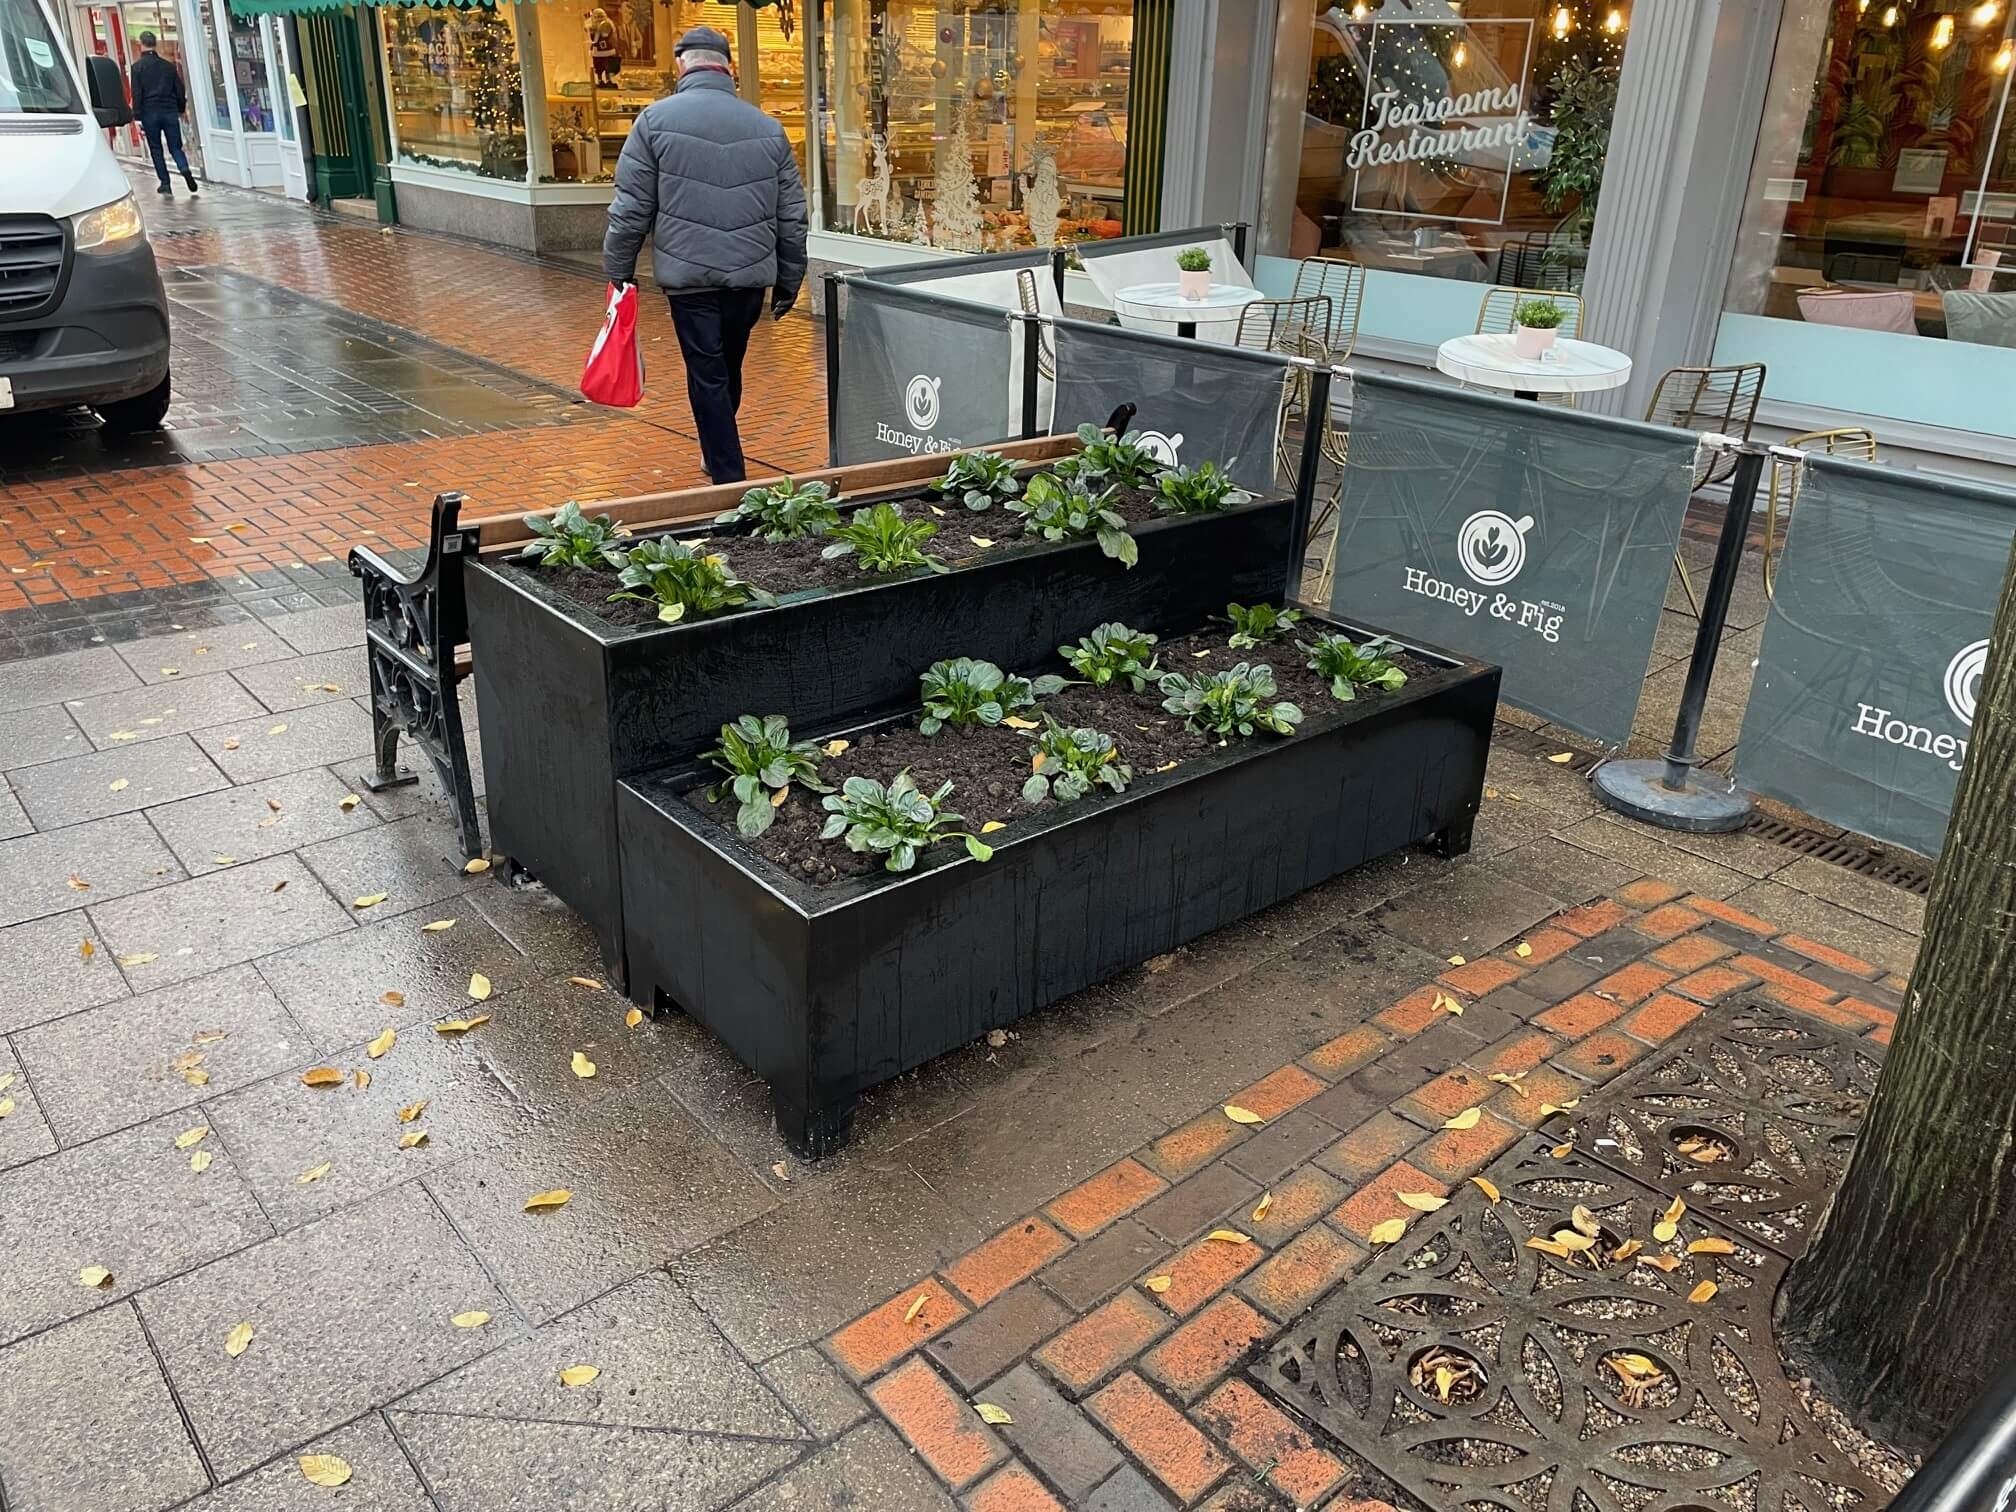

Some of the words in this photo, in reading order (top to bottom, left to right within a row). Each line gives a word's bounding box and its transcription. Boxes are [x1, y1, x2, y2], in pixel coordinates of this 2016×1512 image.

[1371, 83, 1519, 131] Tearooms
[1346, 110, 1538, 169] Restaurant
[875, 422, 922, 454] Honey
[924, 435, 938, 454] &
[939, 439, 961, 454] Fi
[1403, 566, 1487, 616] Honey
[1489, 593, 1517, 621] &
[1517, 601, 1563, 643] Fig
[1851, 702, 1970, 771] Honey
